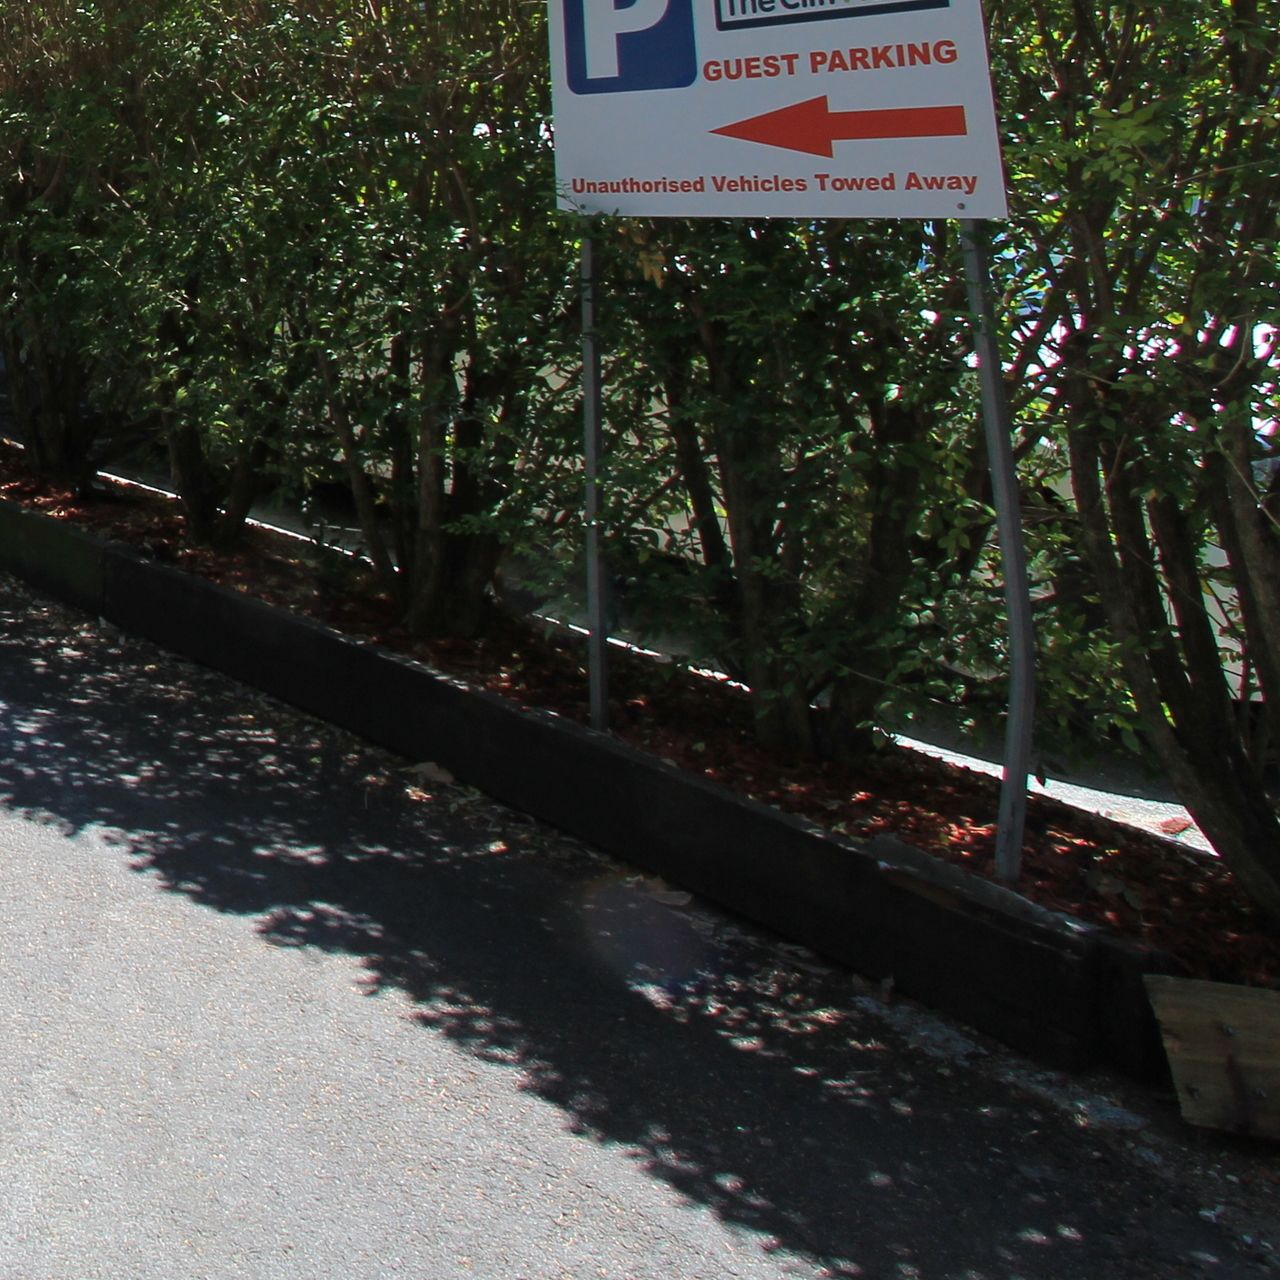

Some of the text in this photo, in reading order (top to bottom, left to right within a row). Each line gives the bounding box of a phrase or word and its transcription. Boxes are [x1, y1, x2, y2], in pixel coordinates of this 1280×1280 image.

[703, 39, 958, 82] GUEST PARKING
[571, 172, 978, 195] Unauthorised Vehicles Towed Away
